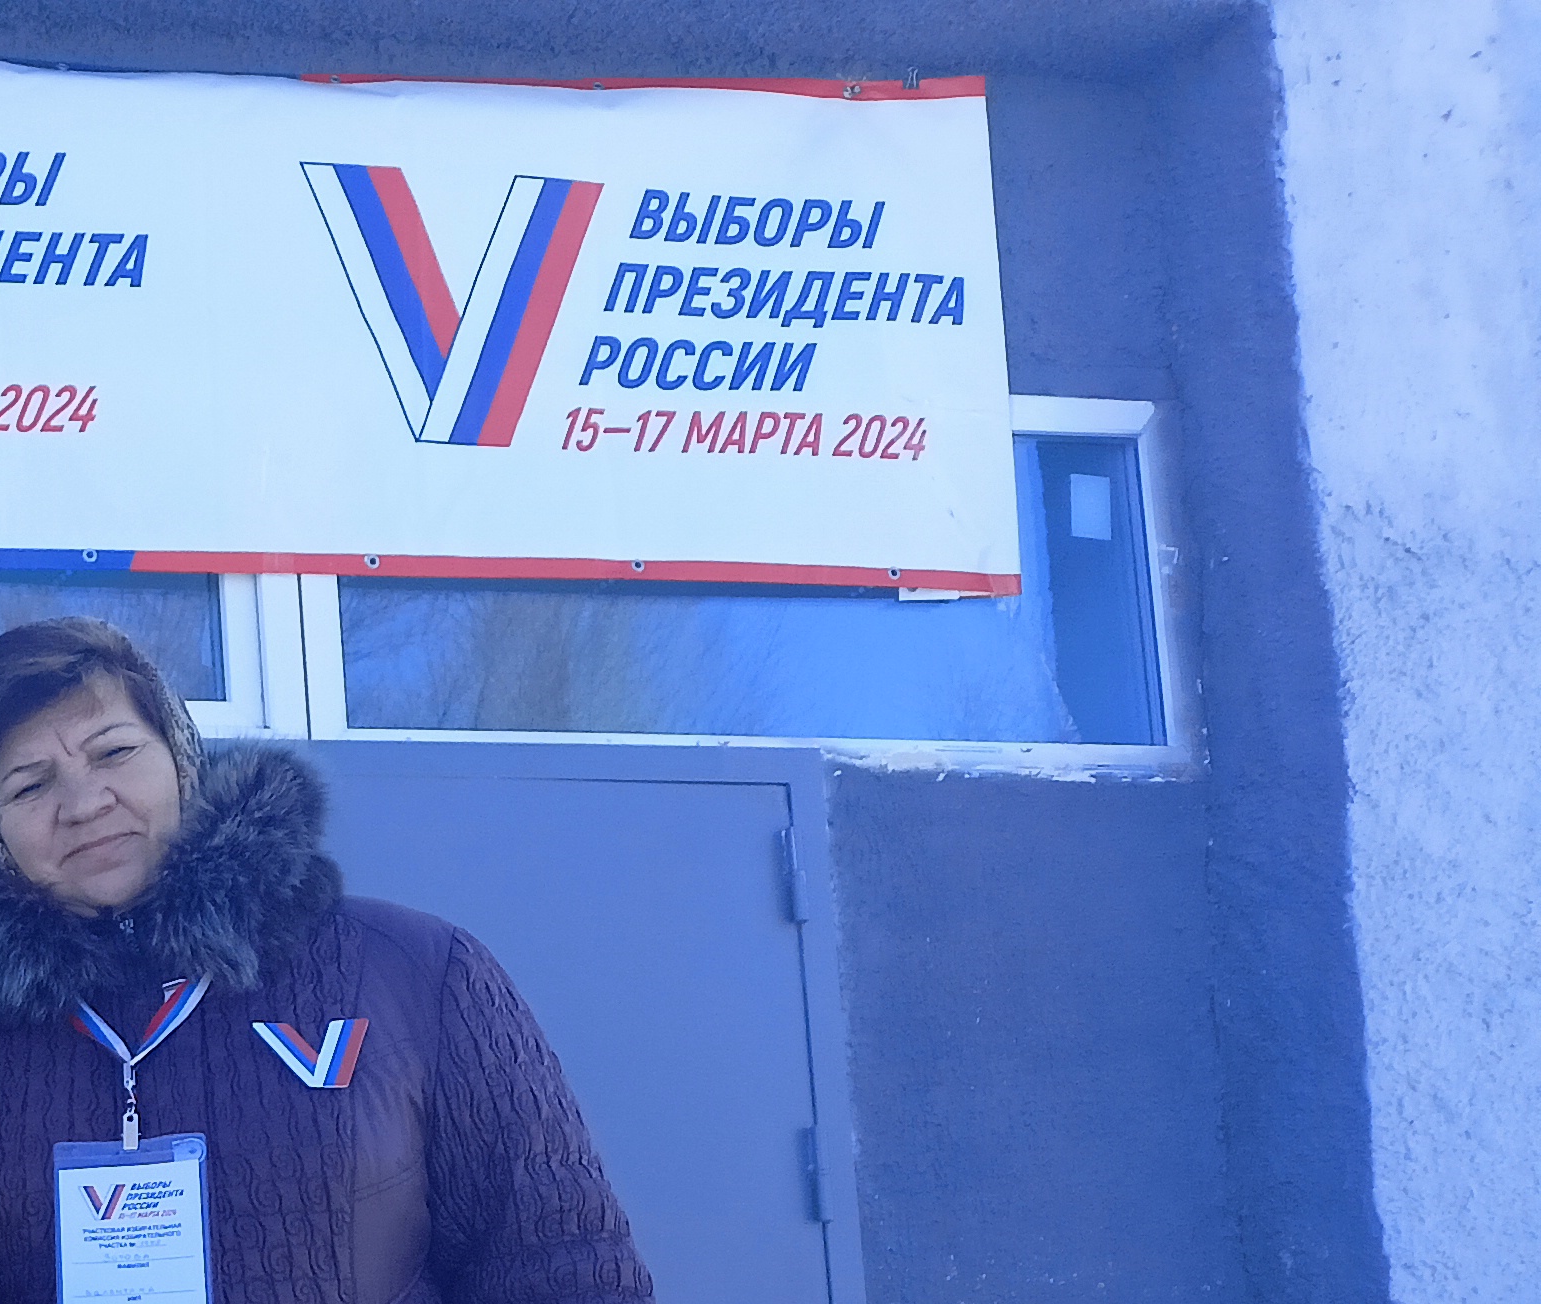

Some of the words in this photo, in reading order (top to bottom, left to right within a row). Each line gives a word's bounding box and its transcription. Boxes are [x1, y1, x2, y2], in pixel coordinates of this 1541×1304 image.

[630, 188, 886, 251] ВЫБОРЫ
[604, 262, 966, 329] ПРЕЗИДЕНТА
[578, 335, 818, 394] РОССИИ
[681, 410, 823, 459] МАРТА
[832, 413, 928, 462] 2024
